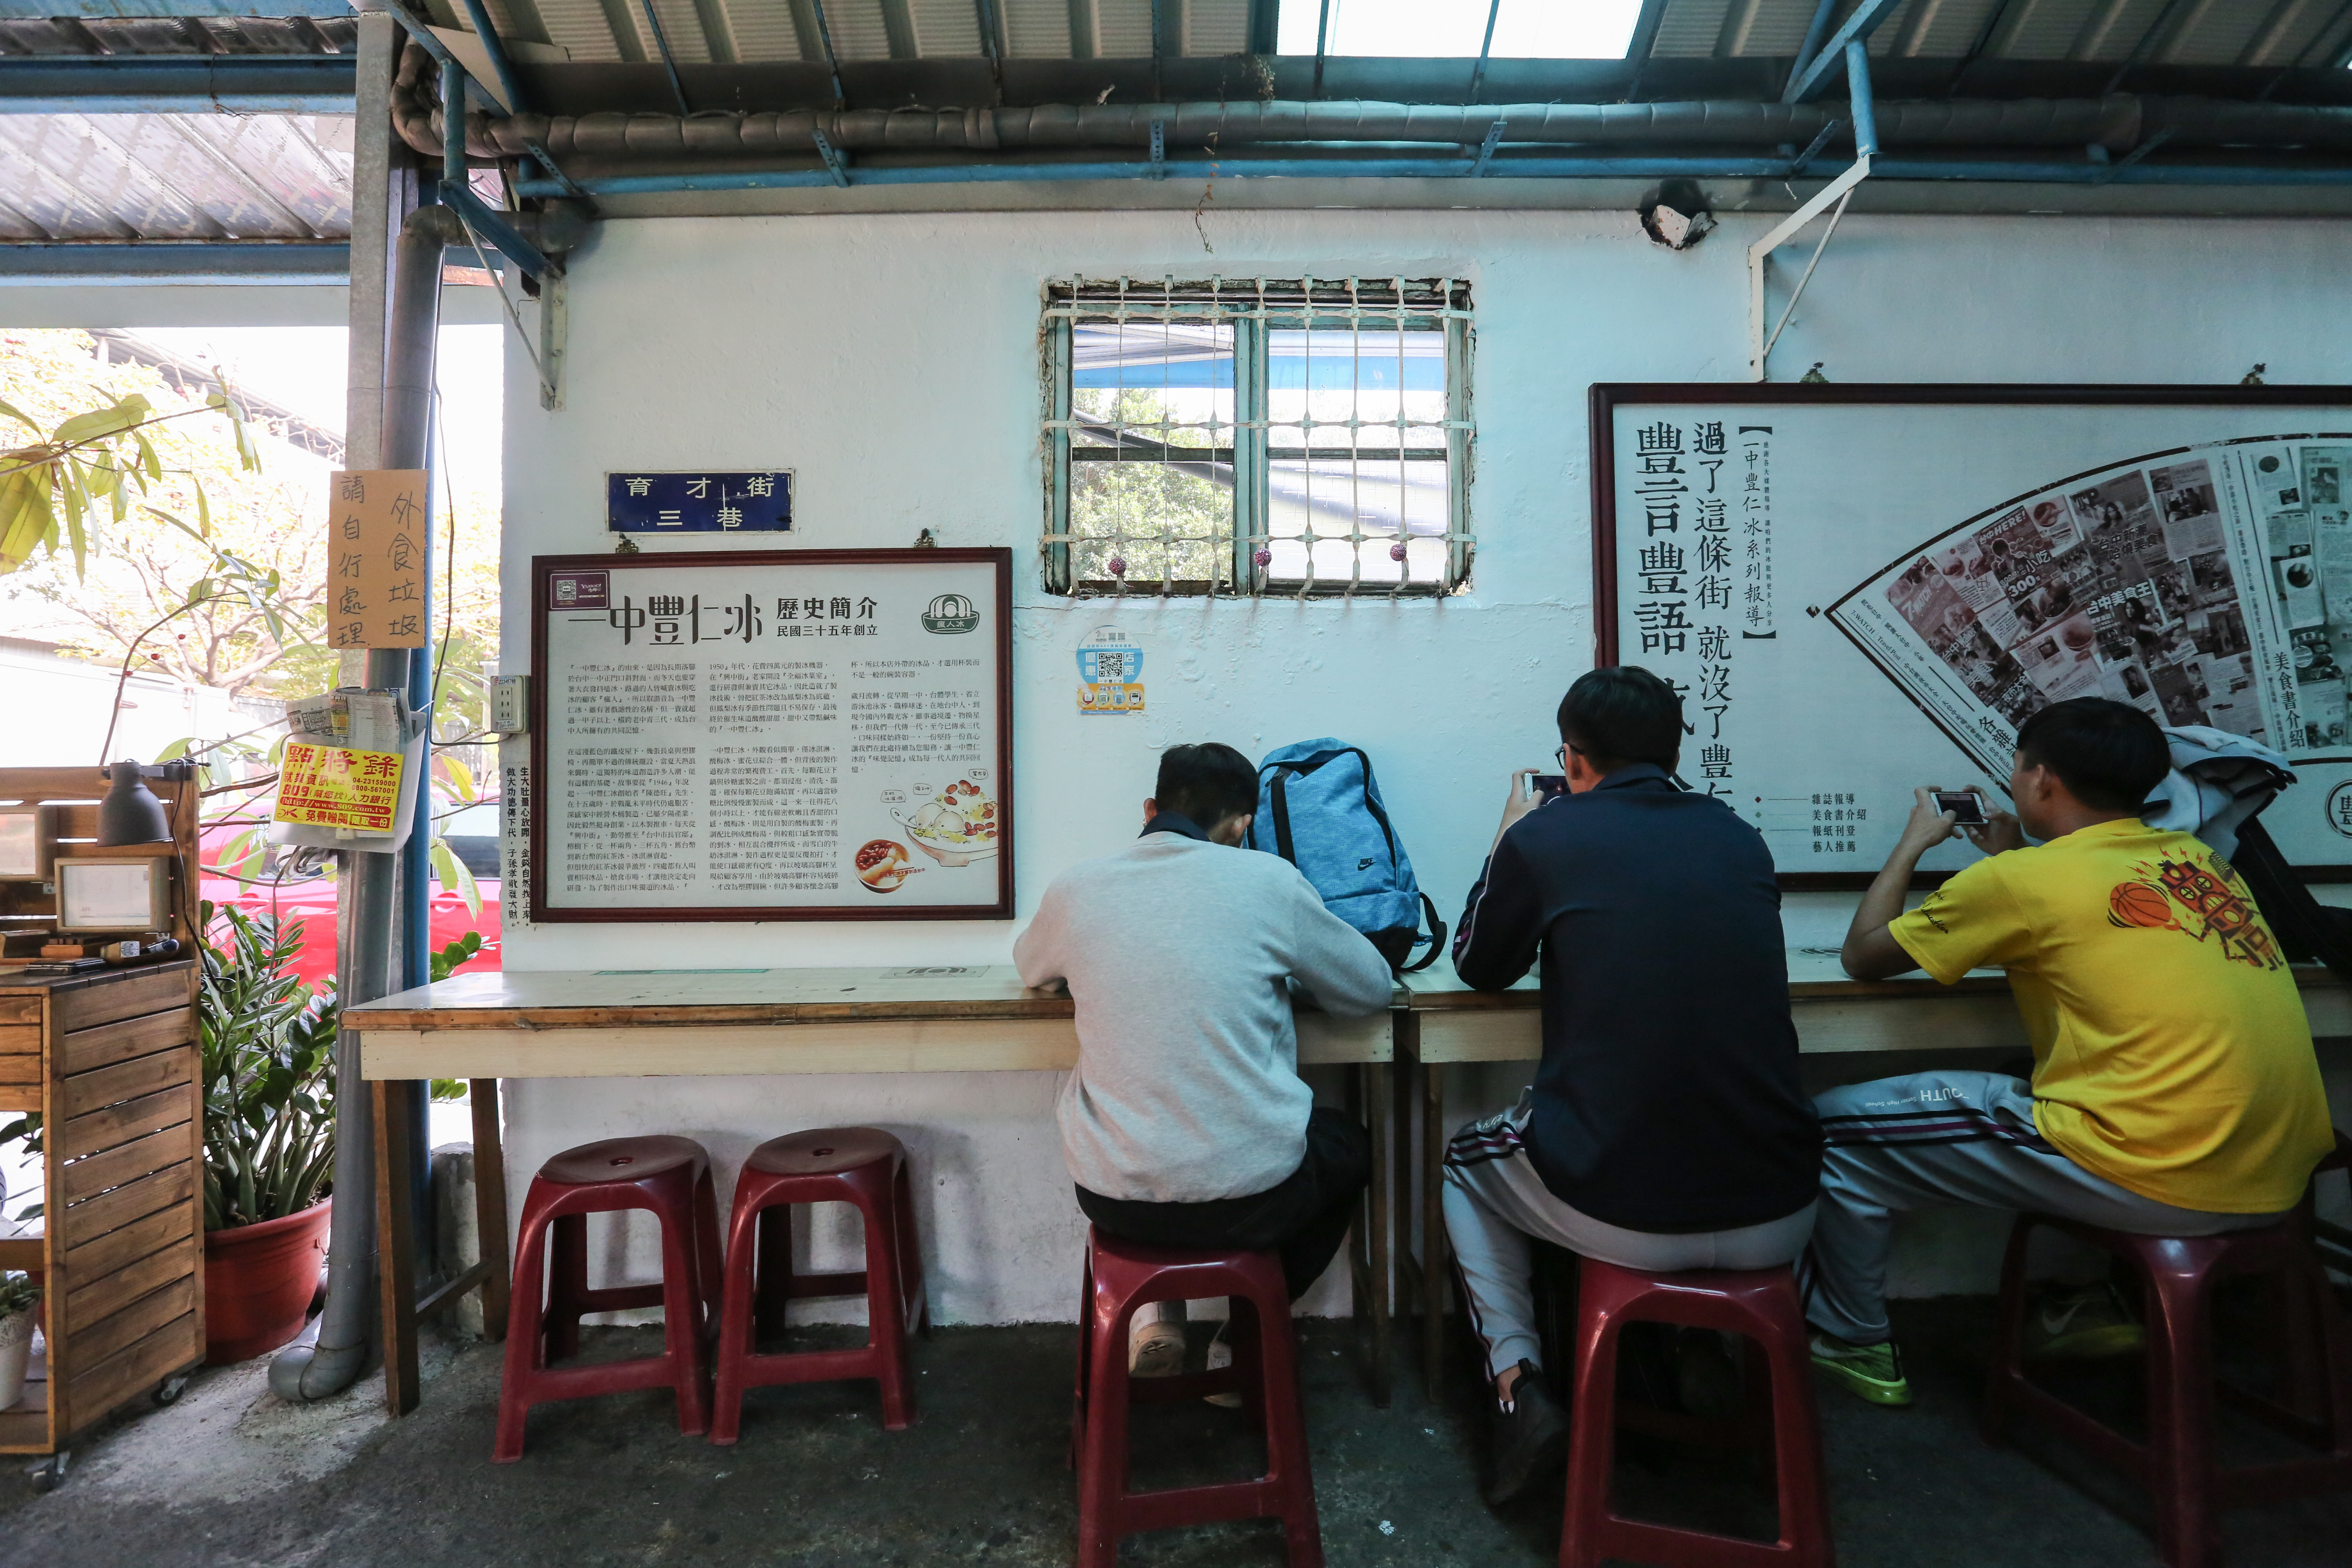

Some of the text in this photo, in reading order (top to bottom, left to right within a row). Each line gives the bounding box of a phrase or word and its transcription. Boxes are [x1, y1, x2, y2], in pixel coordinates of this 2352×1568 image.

[625, 477, 774, 499] 育才街
[657, 507, 742, 527] 三巷
[1693, 421, 1733, 610] 過了這條街
[336, 475, 367, 646] 請自行處理
[388, 492, 421, 637] 外食垃圾
[777, 597, 878, 620] 歷史簡介
[2087, 581, 2153, 616] 台中美食王
[568, 593, 763, 646] 一中豐仁冰
[1851, 609, 1876, 635] 7-WATCH
[777, 624, 878, 637] 民國三十五年創立
[1124, 652, 1134, 676] 店家
[286, 746, 399, 778] 點將錄
[283, 772, 329, 786] 就業資訊
[353, 777, 396, 786] 04-23159000
[352, 785, 394, 794] 0800-567001
[1812, 793, 1855, 805] 雜誌報導
[285, 799, 385, 814] http://www.809.com.tw
[352, 816, 388, 827] 限取一份
[1813, 840, 1856, 853] 藝人推薦
[1359, 857, 1373, 866] NIKE
[1901, 1096, 1917, 1104] Senior
